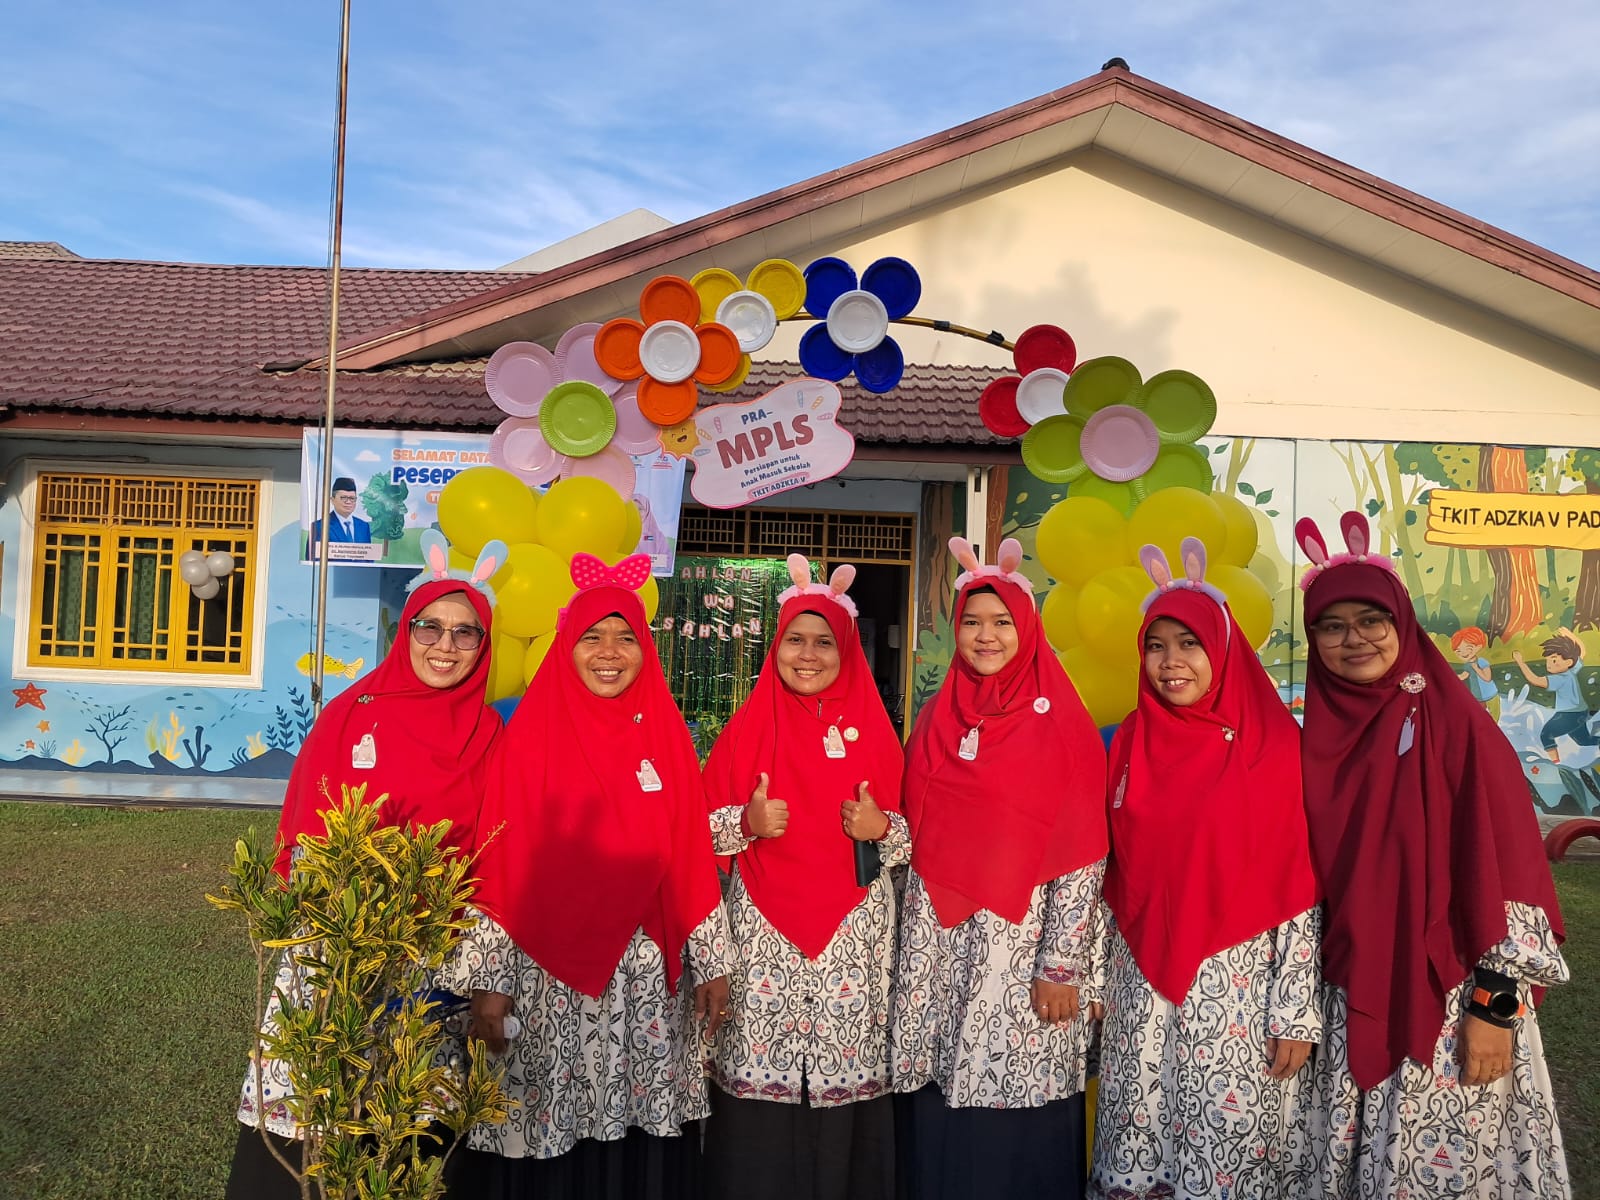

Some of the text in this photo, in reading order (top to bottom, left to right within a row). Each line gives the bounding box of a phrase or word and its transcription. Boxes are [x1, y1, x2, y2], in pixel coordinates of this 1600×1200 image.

[741, 408, 773, 425] PRA-
[716, 413, 814, 469] MPLS
[392, 449, 457, 462] SELAMAT
[744, 453, 801, 476] Persiapan untuk
[740, 461, 811, 489] Anak Masuk Sekolah
[752, 486, 770, 498] TKIT
[770, 478, 800, 491] ADZKIA
[1440, 506, 1600, 528] TKIT ADZKIA V PAD
[681, 565, 752, 580] AHLAN
[703, 593, 735, 610] WA
[663, 616, 762, 639] SAHLAN
